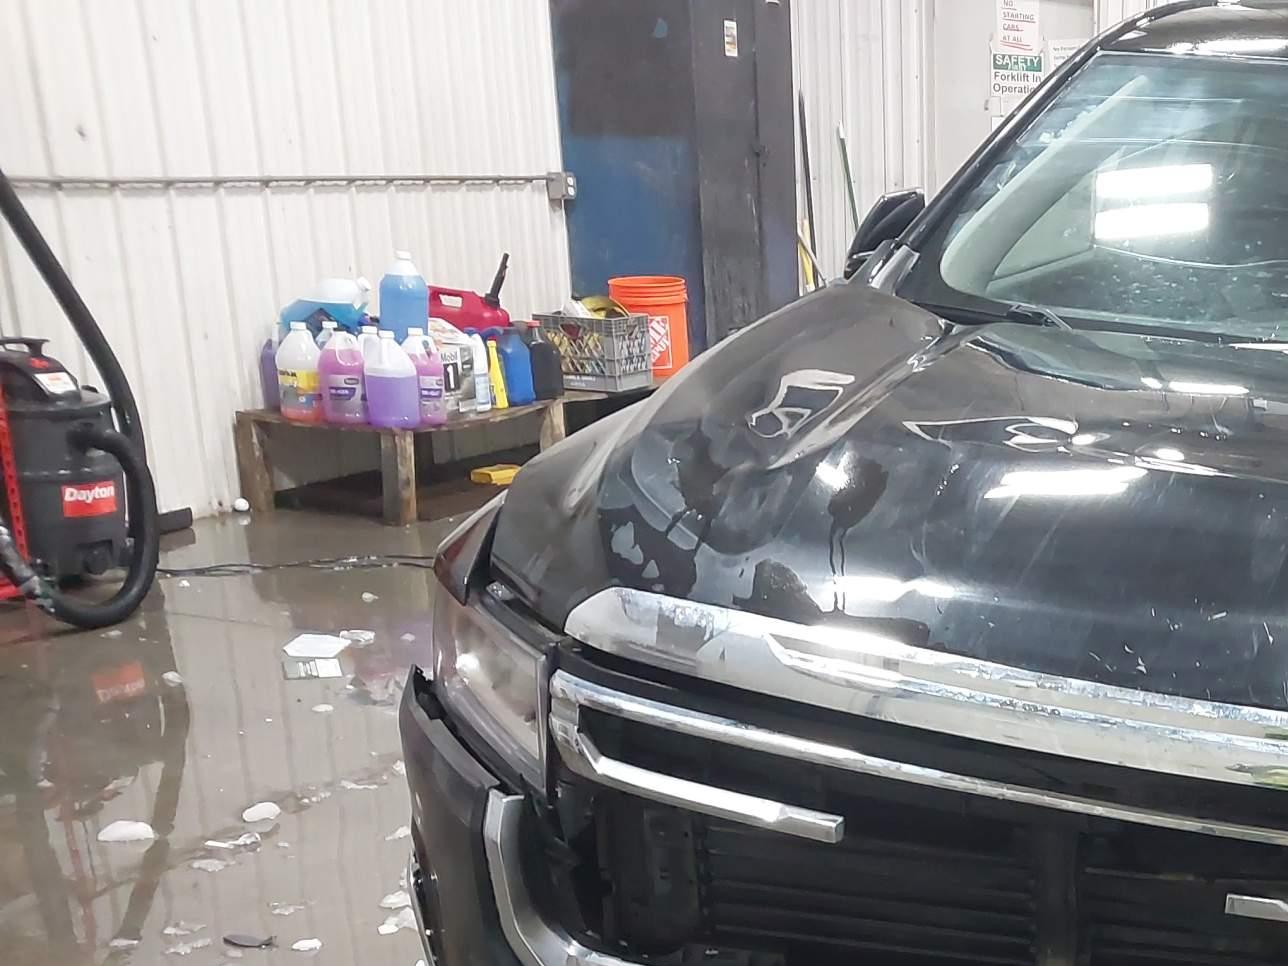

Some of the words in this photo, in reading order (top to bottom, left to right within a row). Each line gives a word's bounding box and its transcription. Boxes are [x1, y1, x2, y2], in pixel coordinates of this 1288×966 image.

[1002, 11, 1035, 20] STARTING
[995, 54, 1040, 67] SAFETY
[994, 71, 1030, 82] Forklift
[1032, 72, 1042, 83] In
[440, 351, 458, 362] Mobil
[64, 484, 115, 503] Dayton
